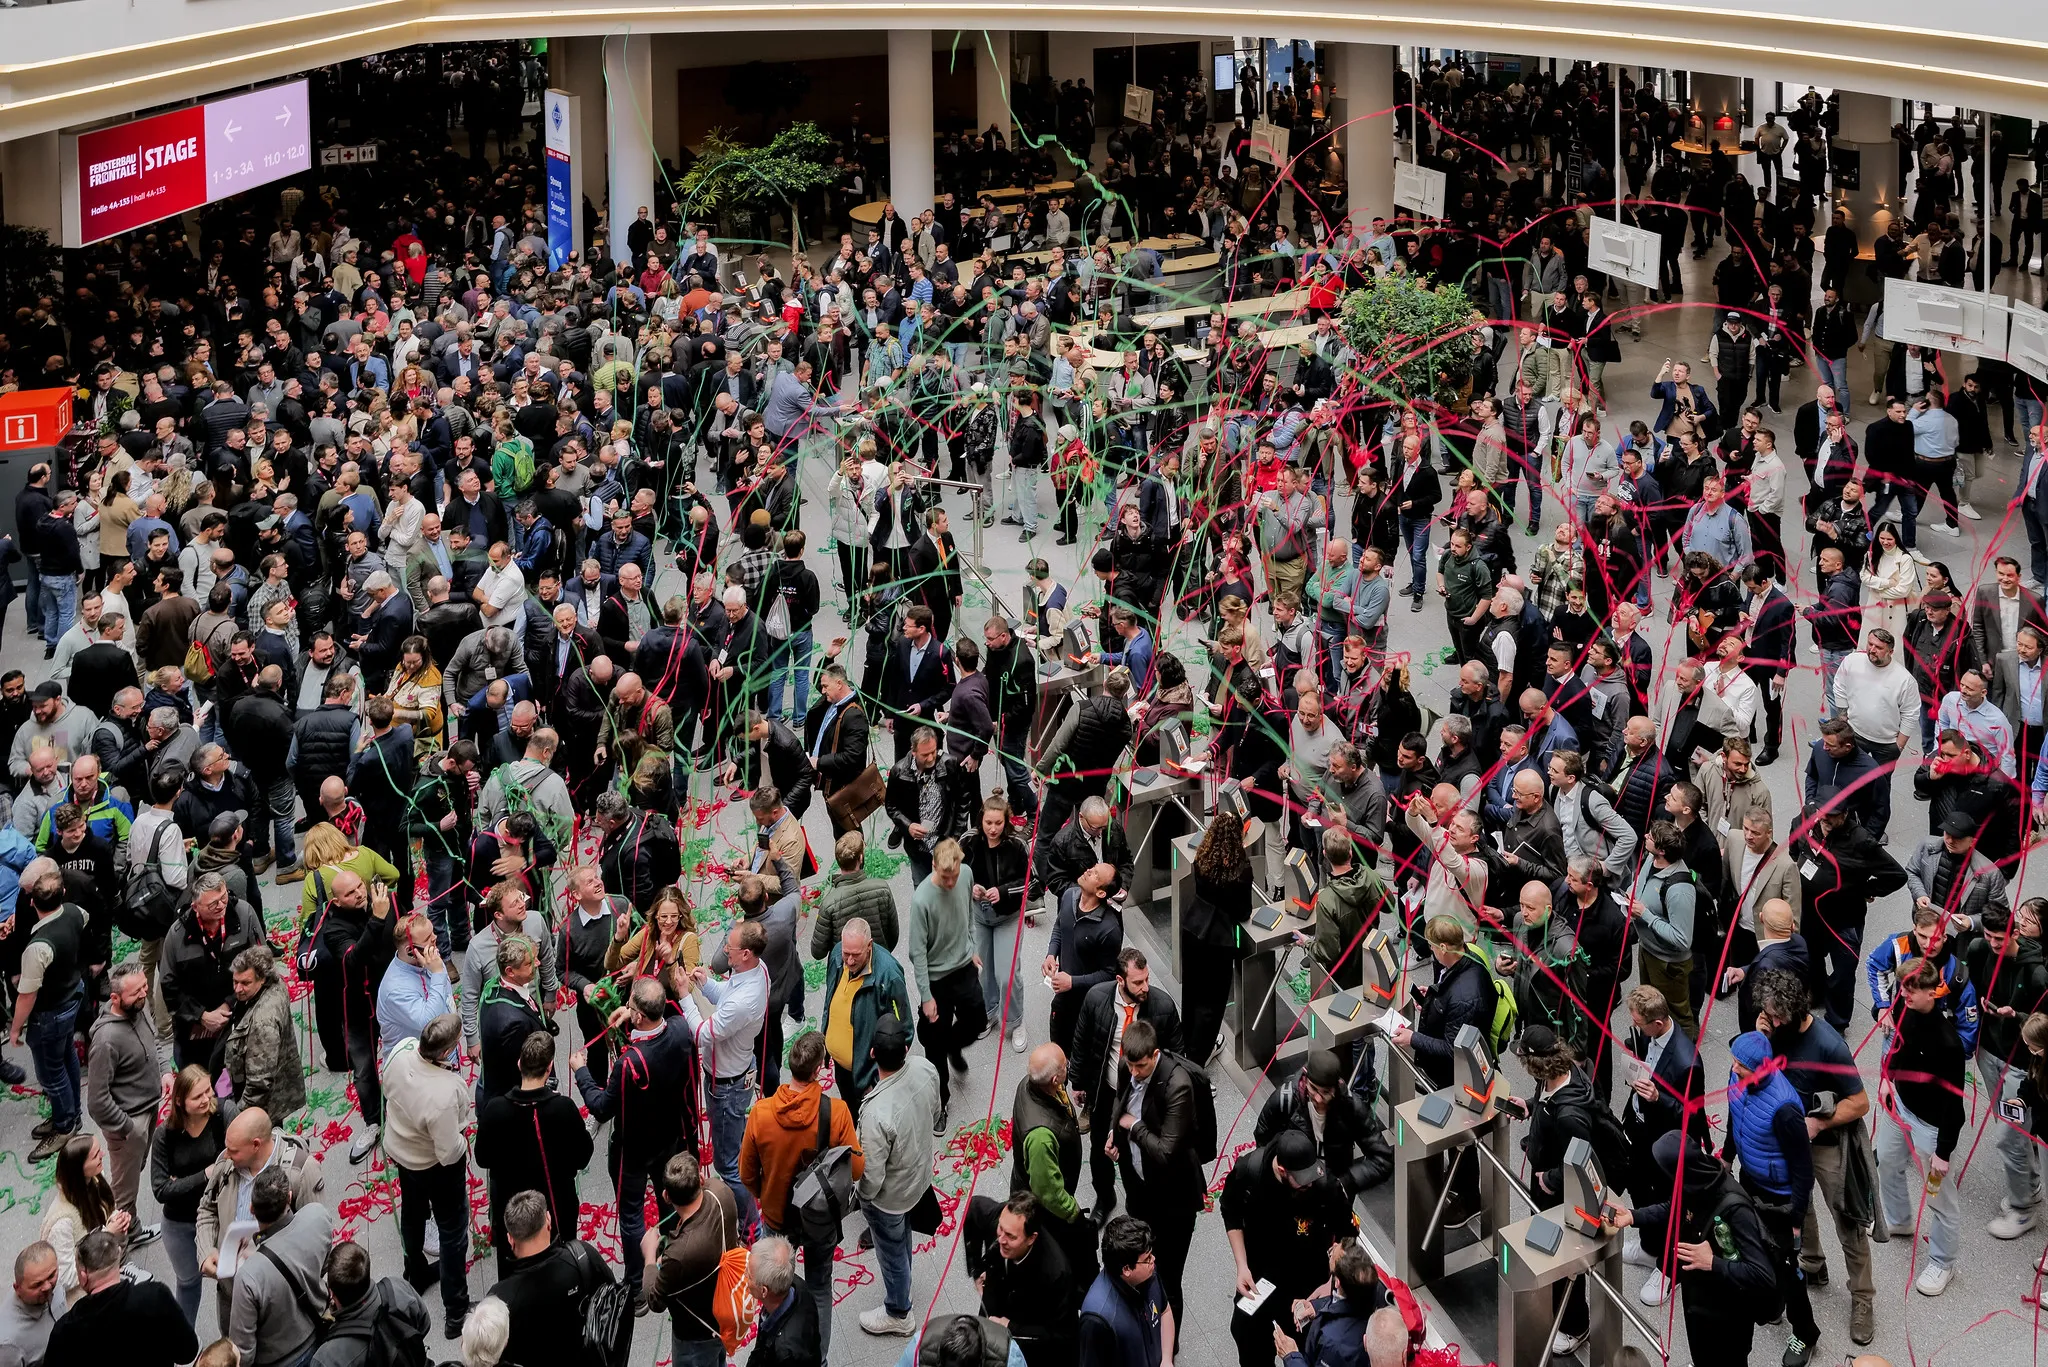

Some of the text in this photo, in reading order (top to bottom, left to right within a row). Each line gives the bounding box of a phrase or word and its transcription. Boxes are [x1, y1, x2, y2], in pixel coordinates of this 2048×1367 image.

[89, 153, 136, 176] FENSTERBAU
[144, 136, 197, 172] STAGE
[264, 144, 305, 168] 11.0 12.0
[226, 166, 232, 180] 3
[240, 160, 254, 176] 3A
[91, 204, 108, 216] Halle
[134, 193, 145, 202] hall
